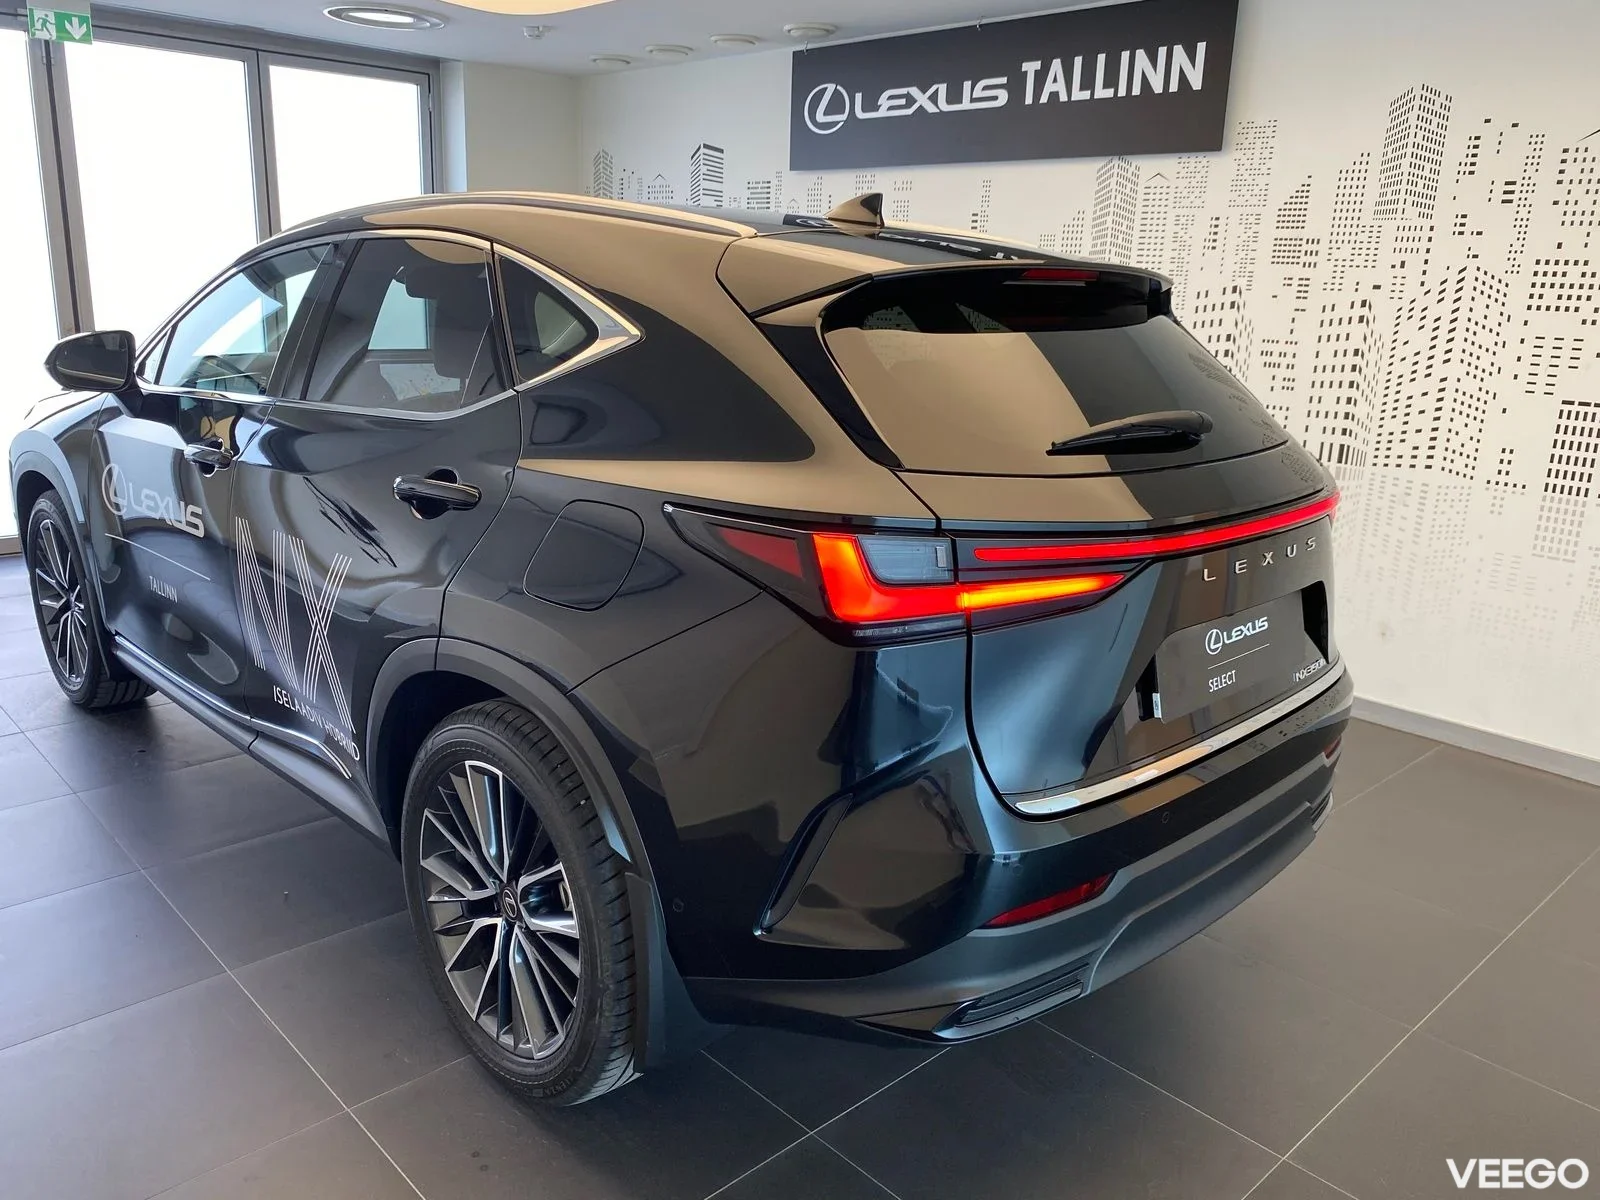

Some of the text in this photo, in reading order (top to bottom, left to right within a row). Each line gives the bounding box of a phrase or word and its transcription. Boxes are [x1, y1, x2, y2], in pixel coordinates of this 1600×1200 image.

[854, 41, 1206, 119] LEXUS TALLINN
[129, 482, 204, 538] LEXUS
[1203, 537, 1316, 582] LEXUS
[149, 576, 178, 603] TALLINN
[236, 516, 356, 734] NX
[1223, 616, 1269, 645] LEXUS
[1208, 670, 1236, 693] SELECT
